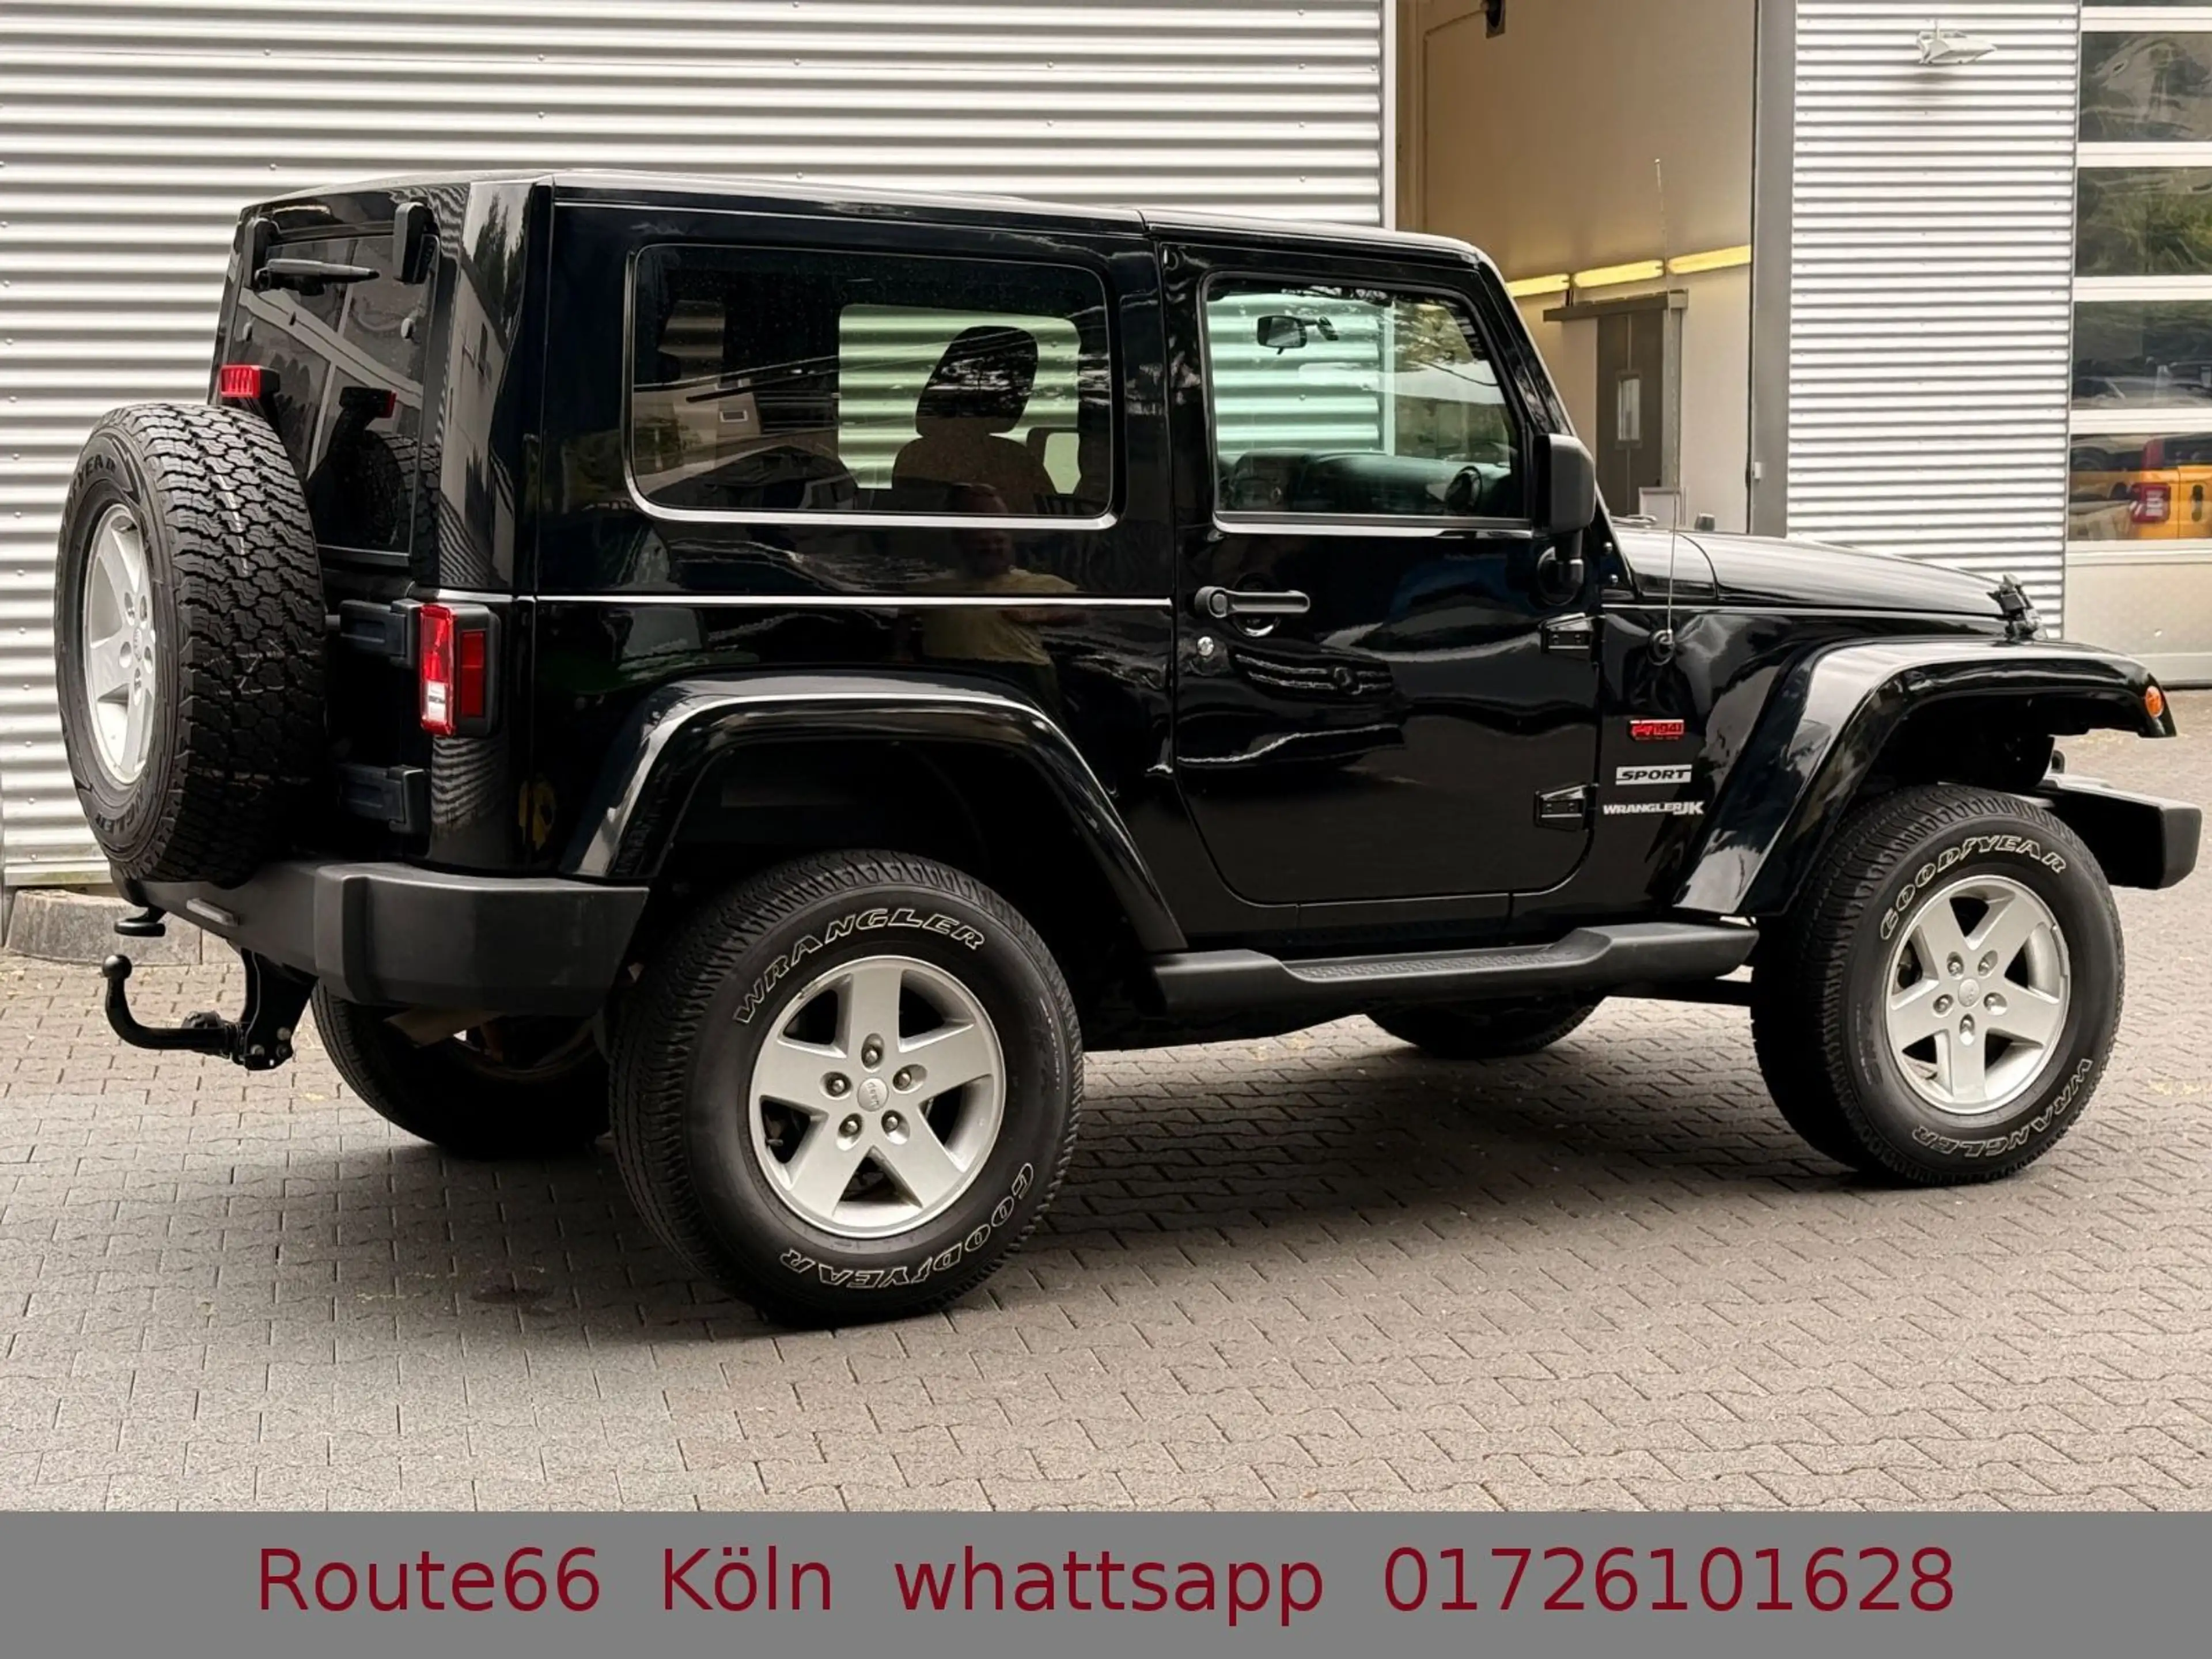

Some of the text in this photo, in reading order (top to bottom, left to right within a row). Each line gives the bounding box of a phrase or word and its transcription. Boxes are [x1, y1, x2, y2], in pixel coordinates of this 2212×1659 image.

[1620, 769, 1692, 781] SPORT
[1880, 835, 2067, 940] GOODYEAR
[733, 908, 985, 1024] WRANGLER
[1912, 1058, 2093, 1157] WRANGLER
[779, 1162, 1034, 1289] GOODYEAR
